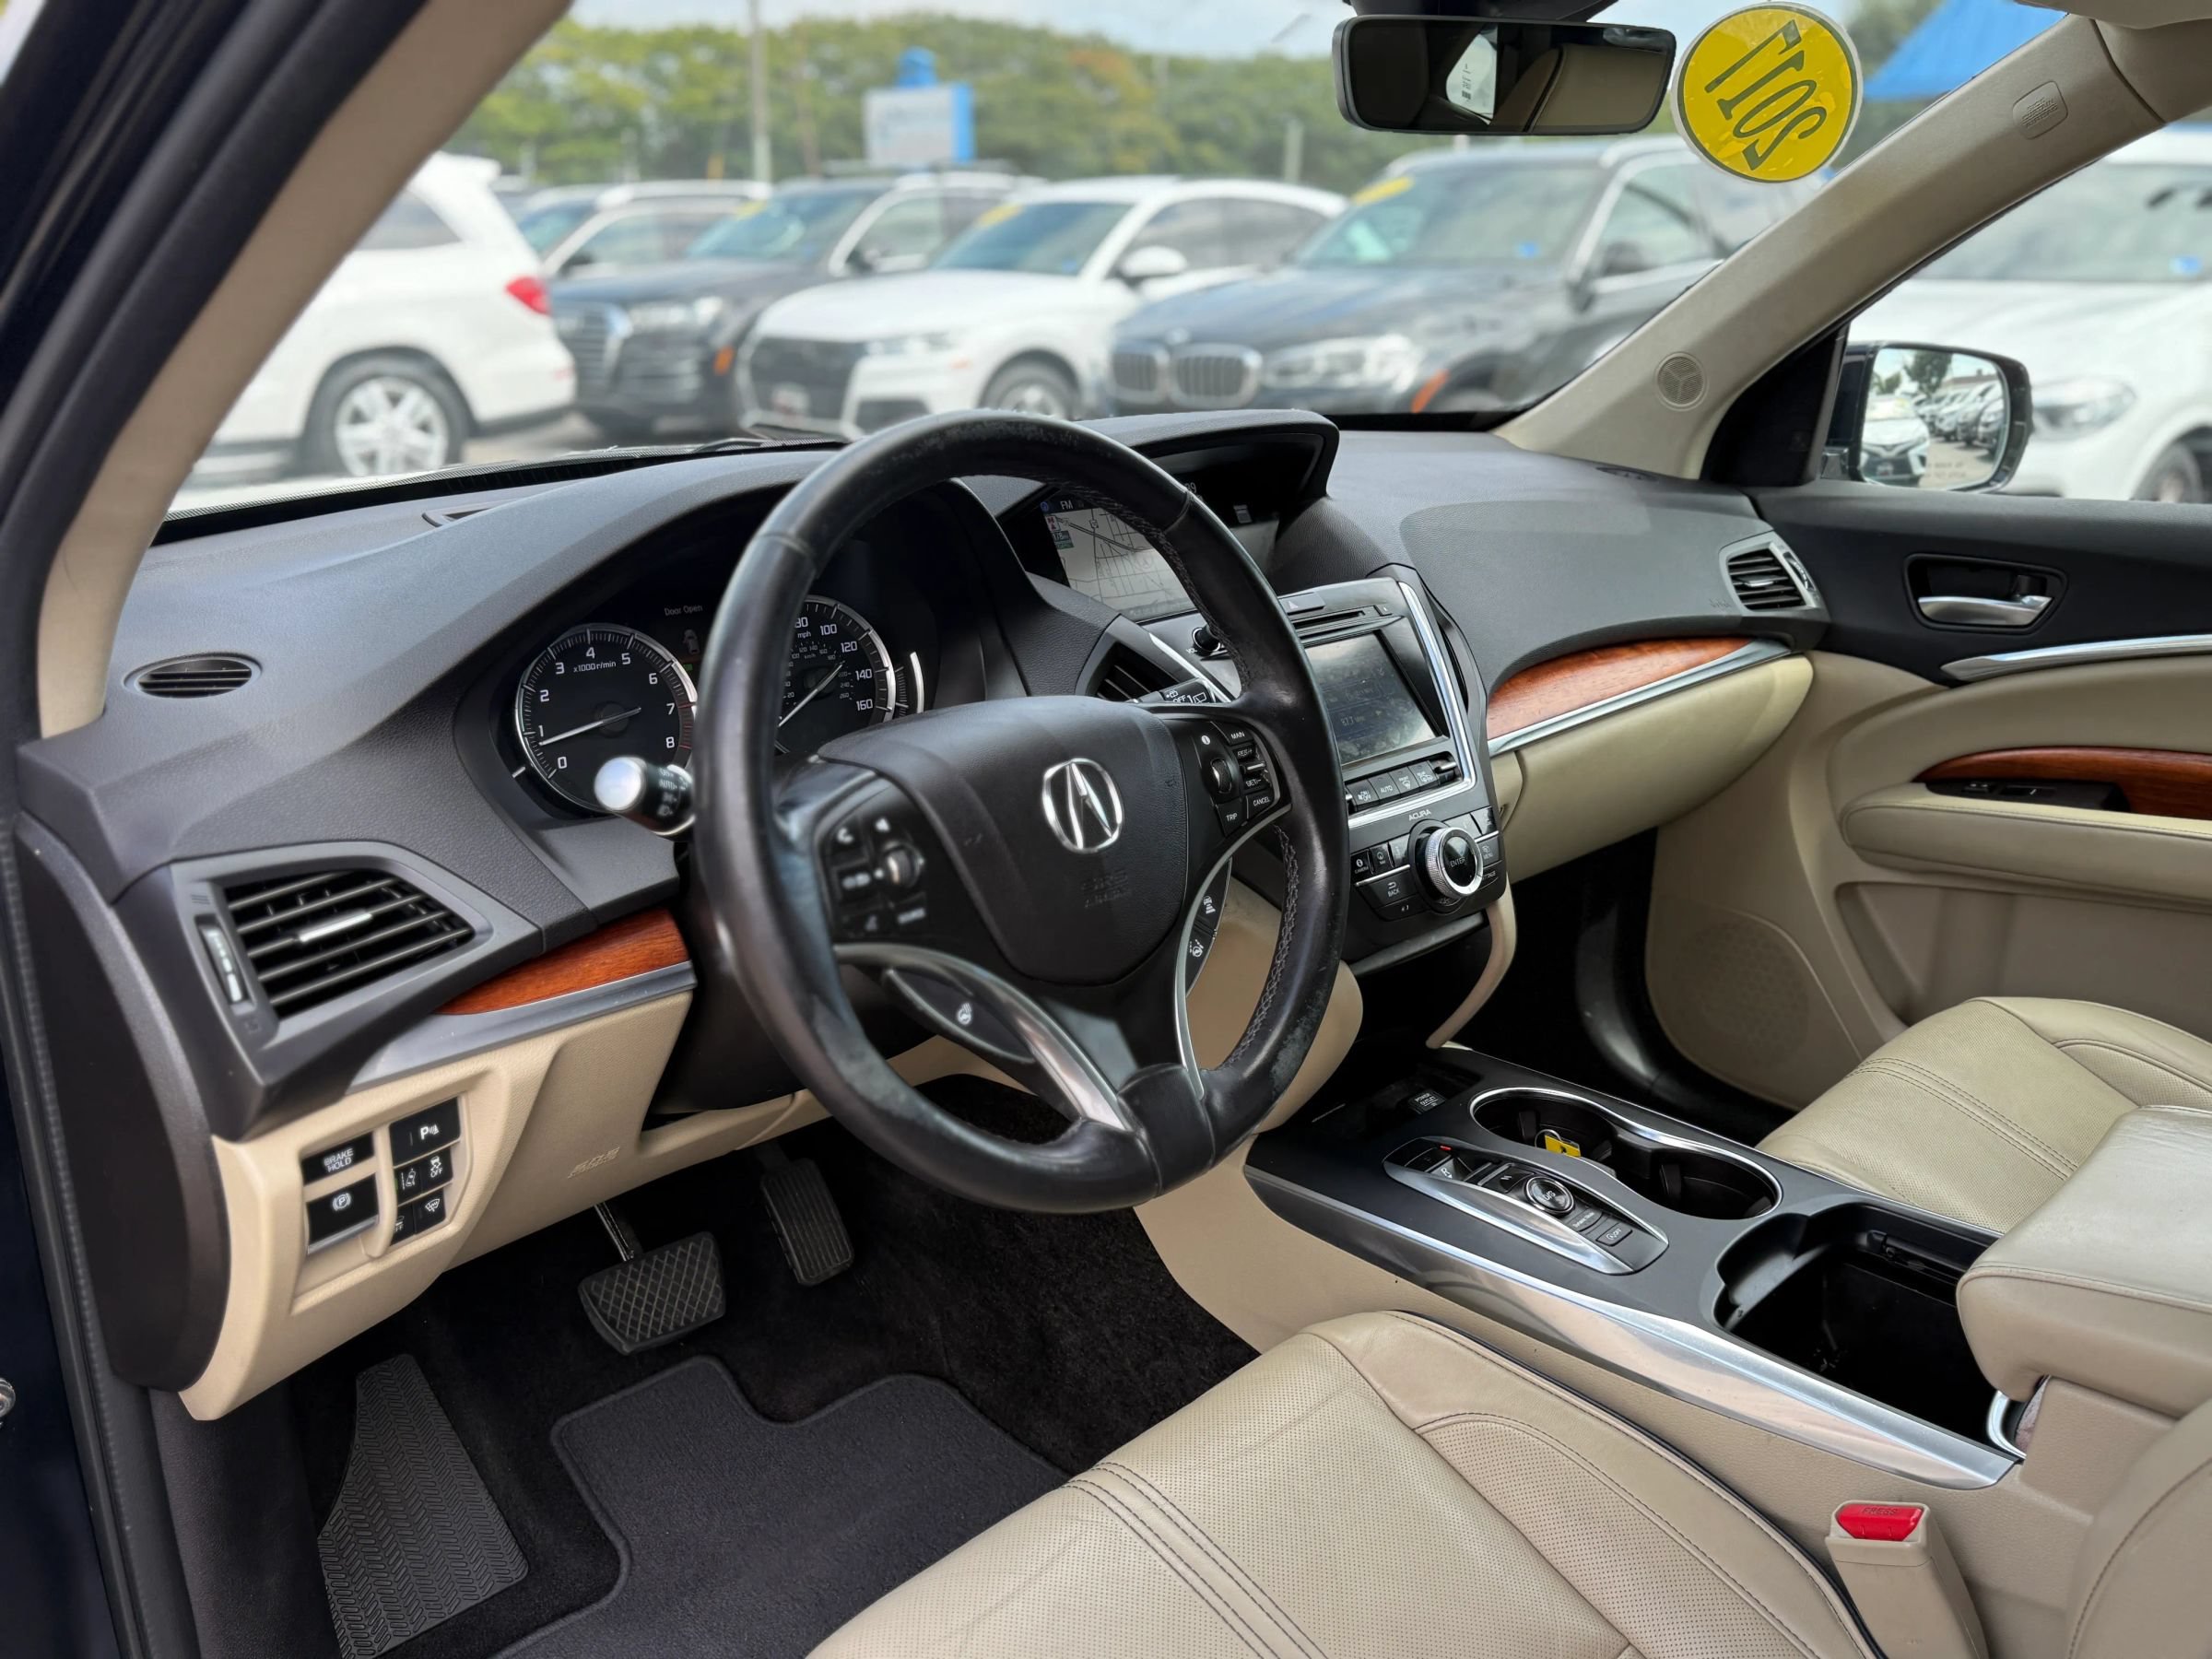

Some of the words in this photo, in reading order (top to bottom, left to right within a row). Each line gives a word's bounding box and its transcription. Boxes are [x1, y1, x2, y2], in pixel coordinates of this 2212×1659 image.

[1061, 500, 1074, 510] FM
[797, 630, 811, 640] mph
[820, 624, 838, 636] 100
[585, 647, 595, 659] 4
[841, 641, 858, 653] 120
[621, 653, 631, 665] 5
[555, 662, 565, 675] 3
[855, 668, 873, 680] 140
[648, 673, 658, 685] 6
[539, 689, 550, 702] 2
[666, 702, 676, 715] 7
[856, 699, 874, 712] 160
[538, 725, 544, 737] 1
[1230, 731, 1245, 740] MAIN
[665, 736, 676, 748] 8
[557, 756, 568, 769] 0
[1380, 784, 1394, 794] AUTO
[1253, 795, 1271, 806] CANCEL
[1226, 812, 1238, 822] TRIP
[1408, 809, 1431, 821] ACURA
[1450, 856, 1466, 868] ENTER
[1387, 888, 1401, 898] BACK
[420, 1125, 429, 1140] P
[324, 1147, 354, 1167] BRAKE
[327, 1157, 352, 1173] HOLD
[430, 1168, 443, 1179] OFF
